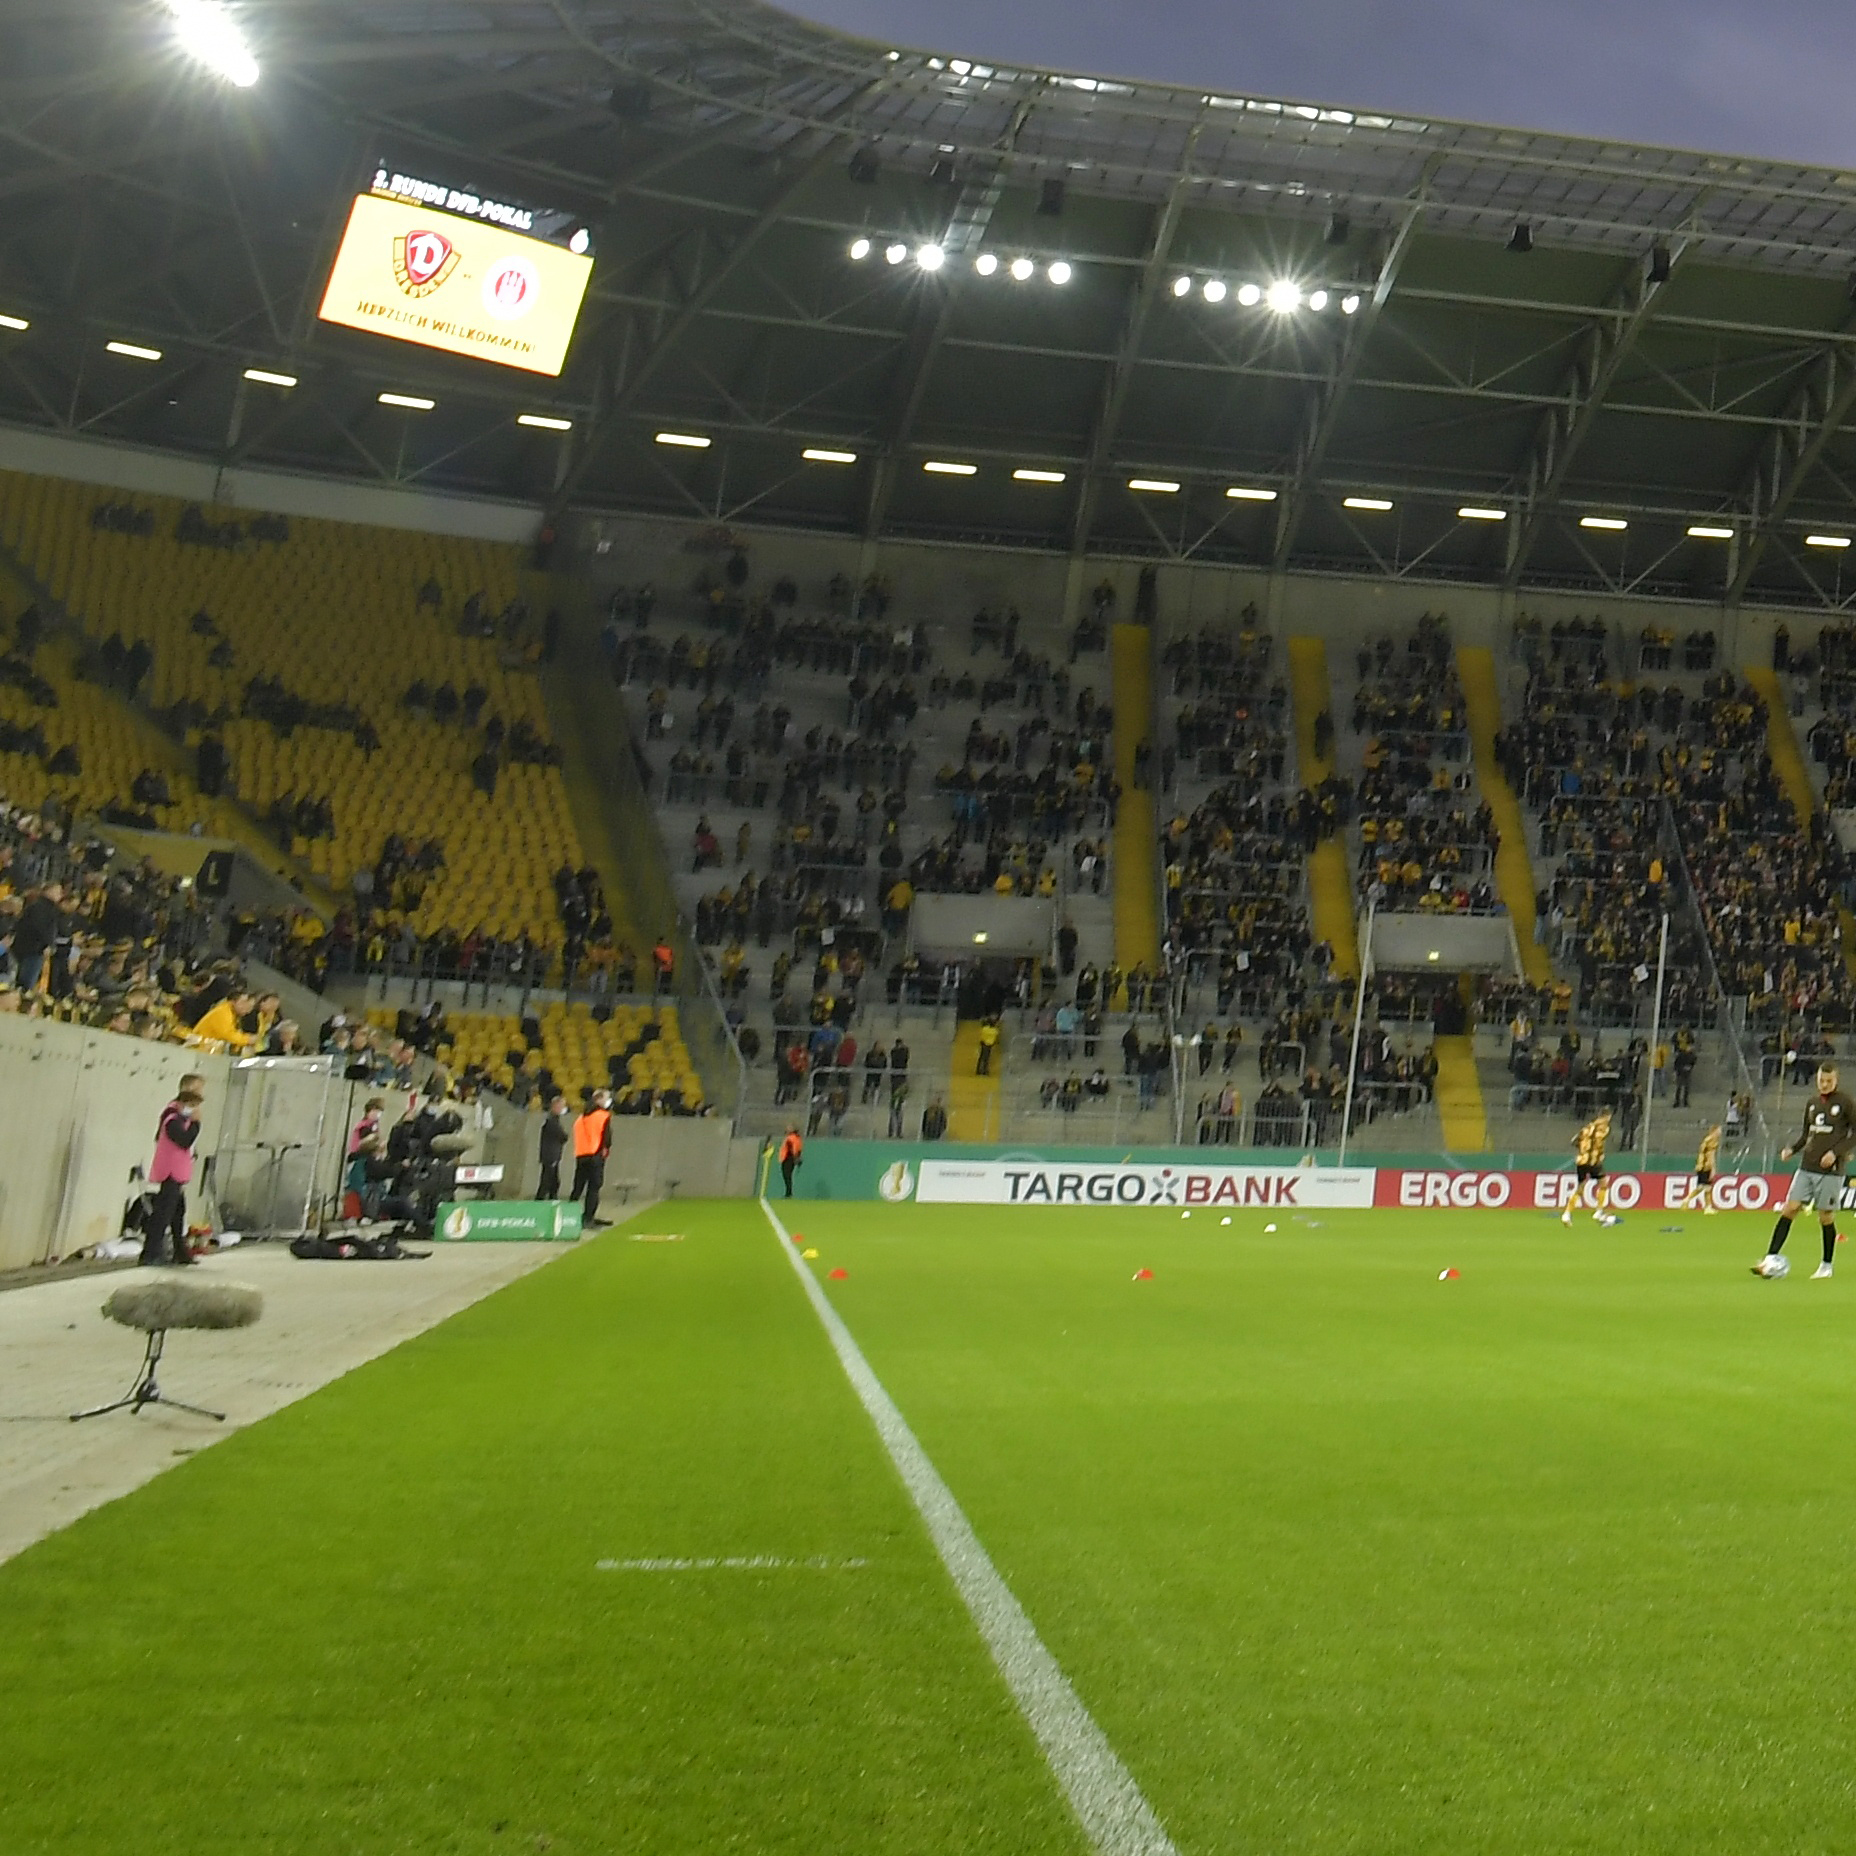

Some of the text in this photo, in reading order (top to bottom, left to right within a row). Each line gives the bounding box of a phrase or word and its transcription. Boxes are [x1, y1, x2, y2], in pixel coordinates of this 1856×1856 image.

[391, 173, 448, 207] RUNDE
[449, 190, 534, 230] DFB-POKAL
[357, 300, 428, 329] HERZLICH
[1400, 1171, 1511, 1208] ERGO
